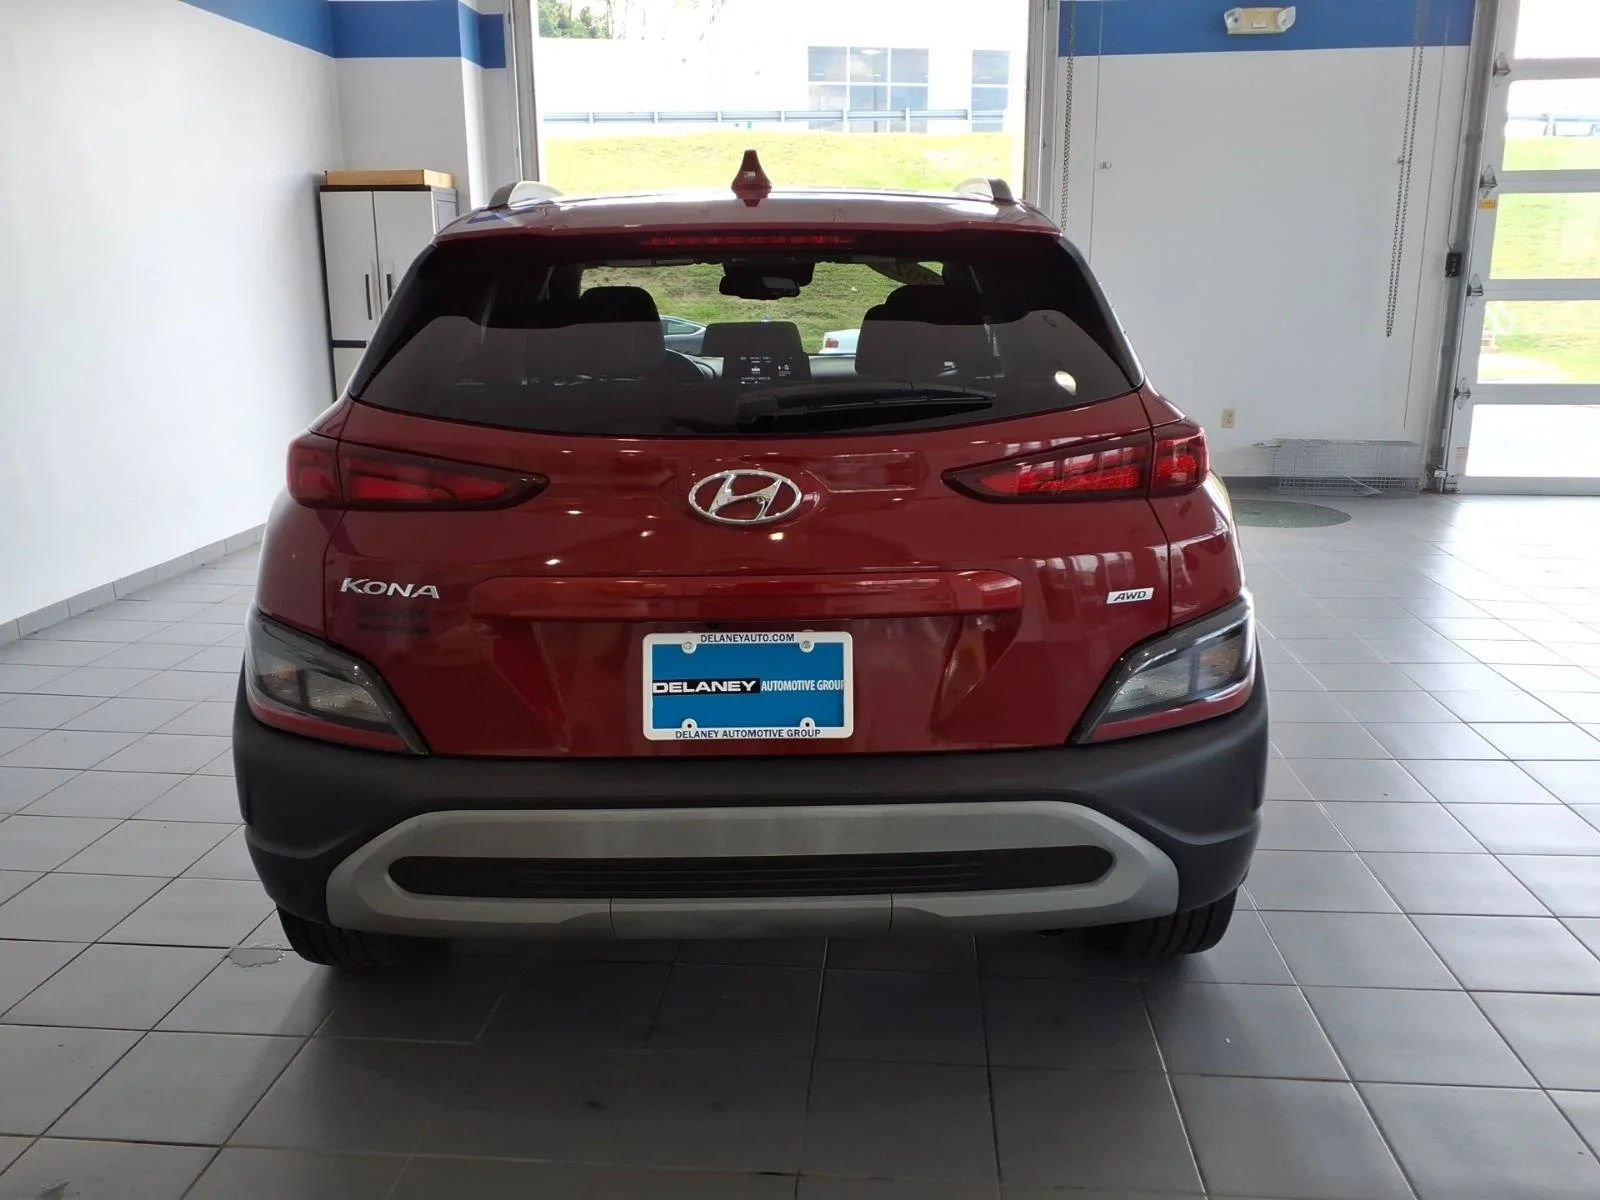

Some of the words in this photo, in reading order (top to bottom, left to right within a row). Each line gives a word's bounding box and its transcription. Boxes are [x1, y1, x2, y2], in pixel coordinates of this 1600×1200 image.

[340, 577, 440, 599] KONA
[1113, 590, 1147, 601] AWD
[700, 633, 795, 643] DELANEYAUTO.COM
[653, 680, 757, 693] DELANEY
[761, 680, 815, 691] AUTOMOTIVE
[675, 730, 719, 739] DELANEY
[722, 729, 784, 738] AUTOMOTIVE
[787, 729, 821, 738] GROUP
